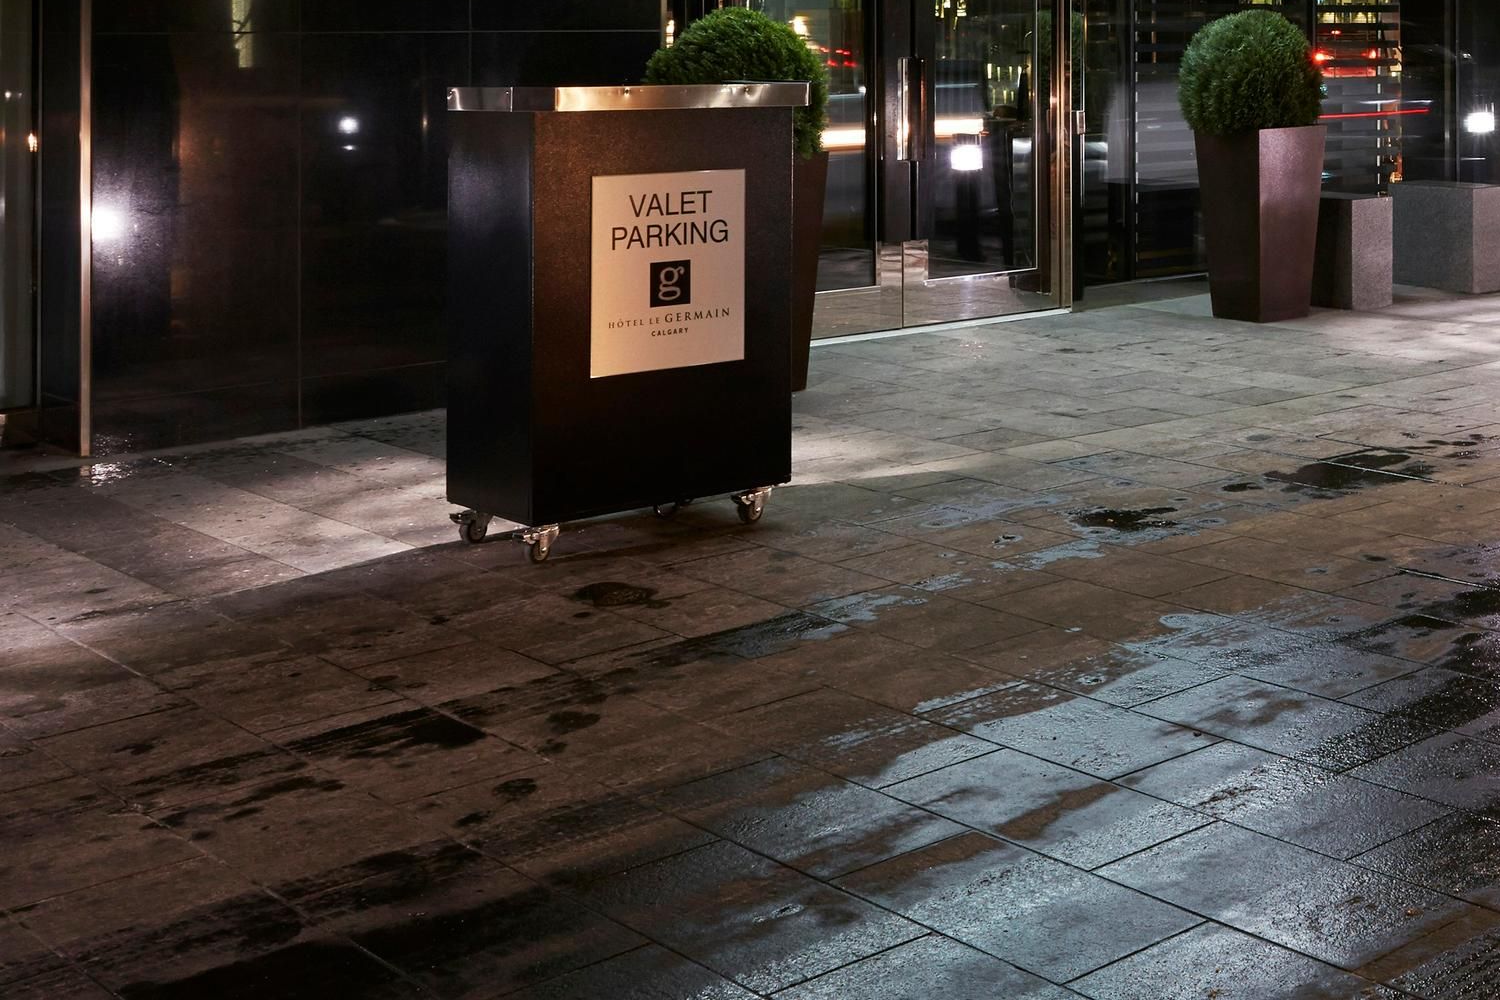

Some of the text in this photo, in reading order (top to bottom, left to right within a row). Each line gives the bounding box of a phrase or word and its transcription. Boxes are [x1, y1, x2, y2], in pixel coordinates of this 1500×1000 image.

[629, 190, 713, 218] VALET
[612, 219, 729, 250] PARKING
[608, 307, 731, 329] HÔTEL LE GERMAIN
[651, 327, 689, 337] CALGARY
